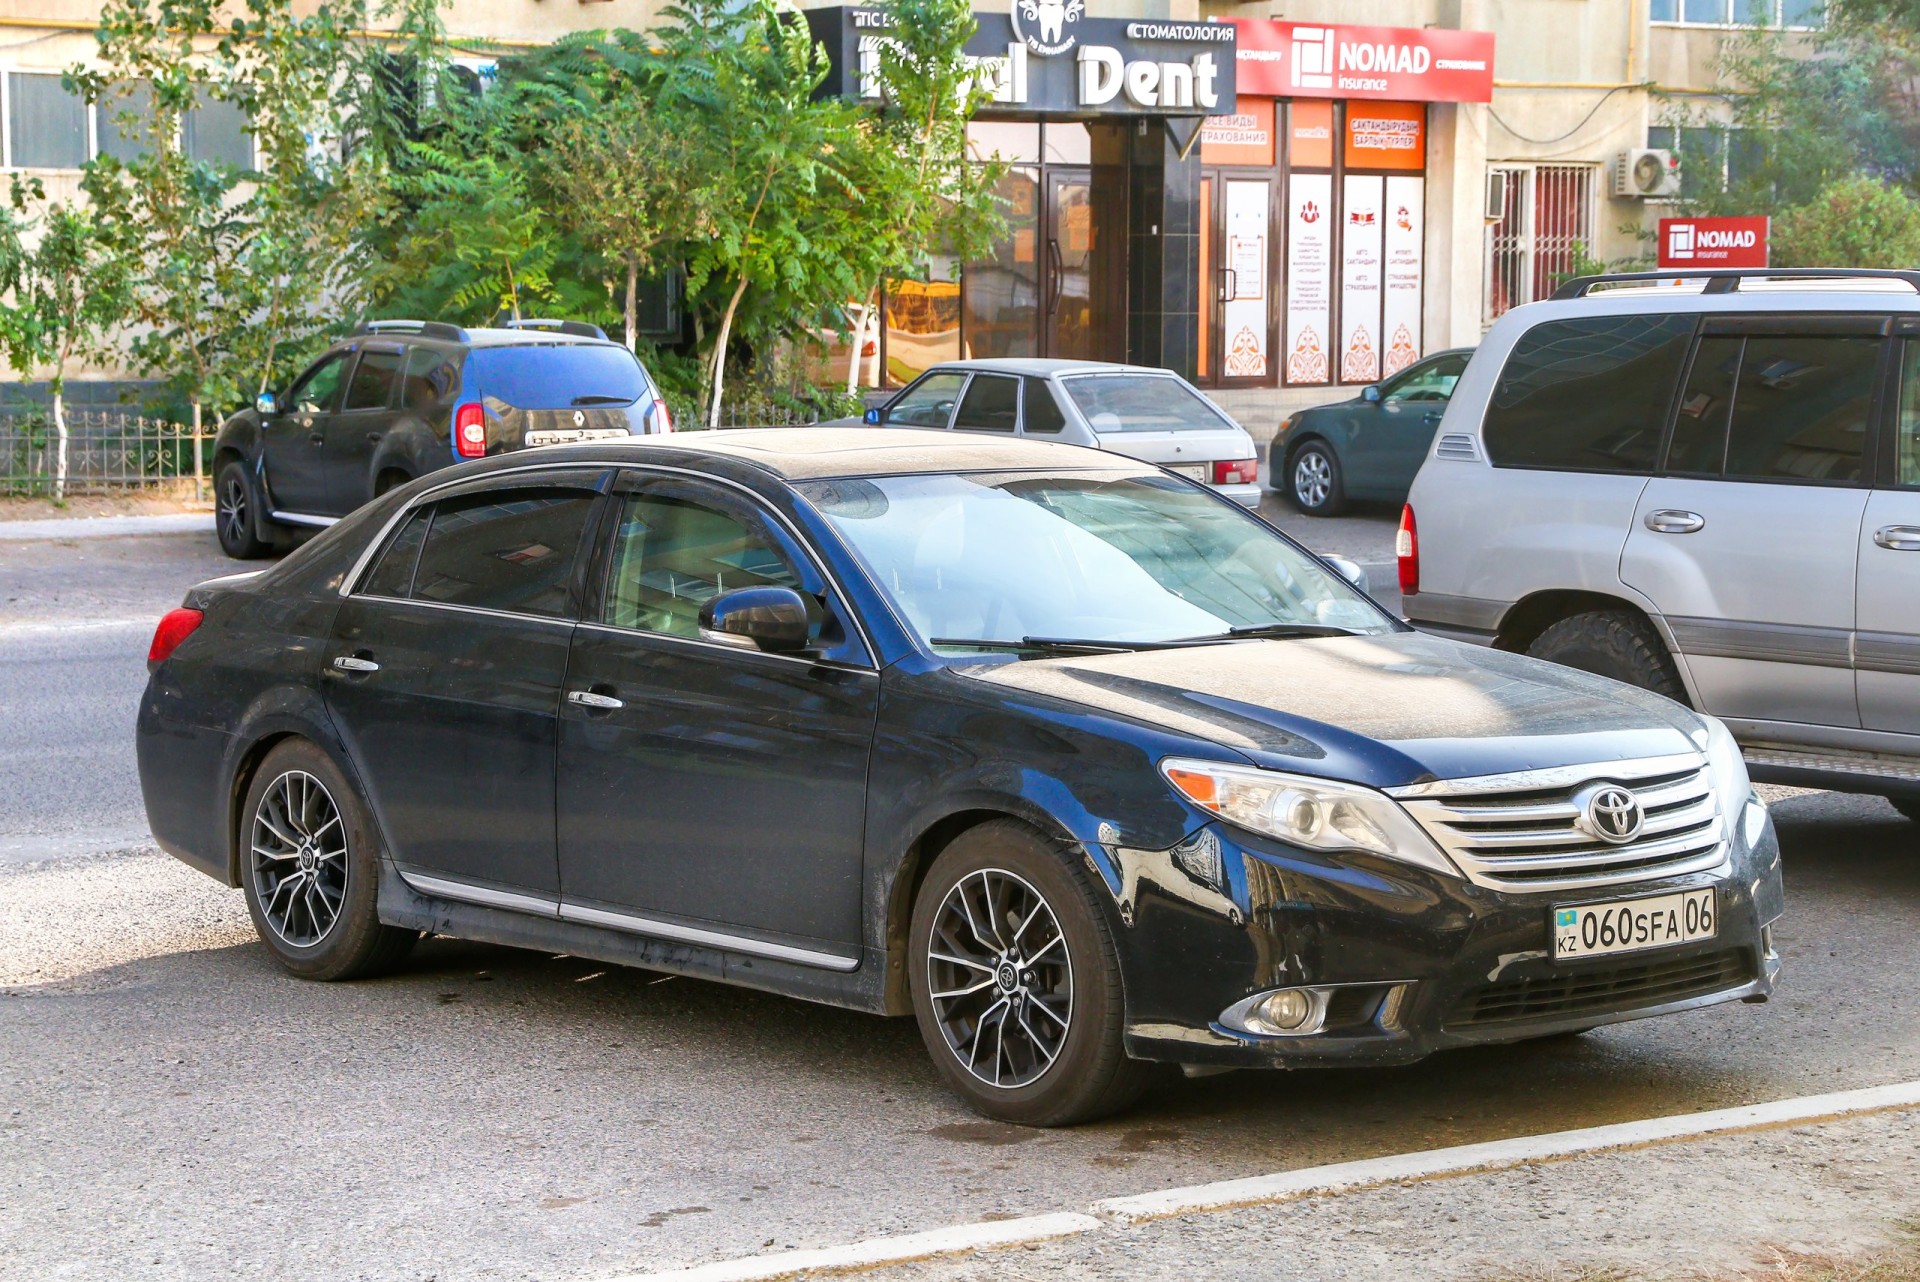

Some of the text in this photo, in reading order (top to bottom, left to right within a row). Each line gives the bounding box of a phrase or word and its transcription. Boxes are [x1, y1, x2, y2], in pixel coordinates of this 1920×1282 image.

[1128, 23, 1234, 41] СТОМАТОЛОГИЯ
[1339, 42, 1431, 75] NOMAD
[1077, 44, 1218, 108] Dent
[1338, 74, 1388, 91] insurance
[1226, 116, 1255, 127] ВИДЫ
[1201, 131, 1266, 143] ТРАХОВАНИЯ
[1697, 230, 1756, 248] NOMAD
[1581, 895, 1712, 950] 060SFA 06
[1557, 935, 1577, 953] KZ
